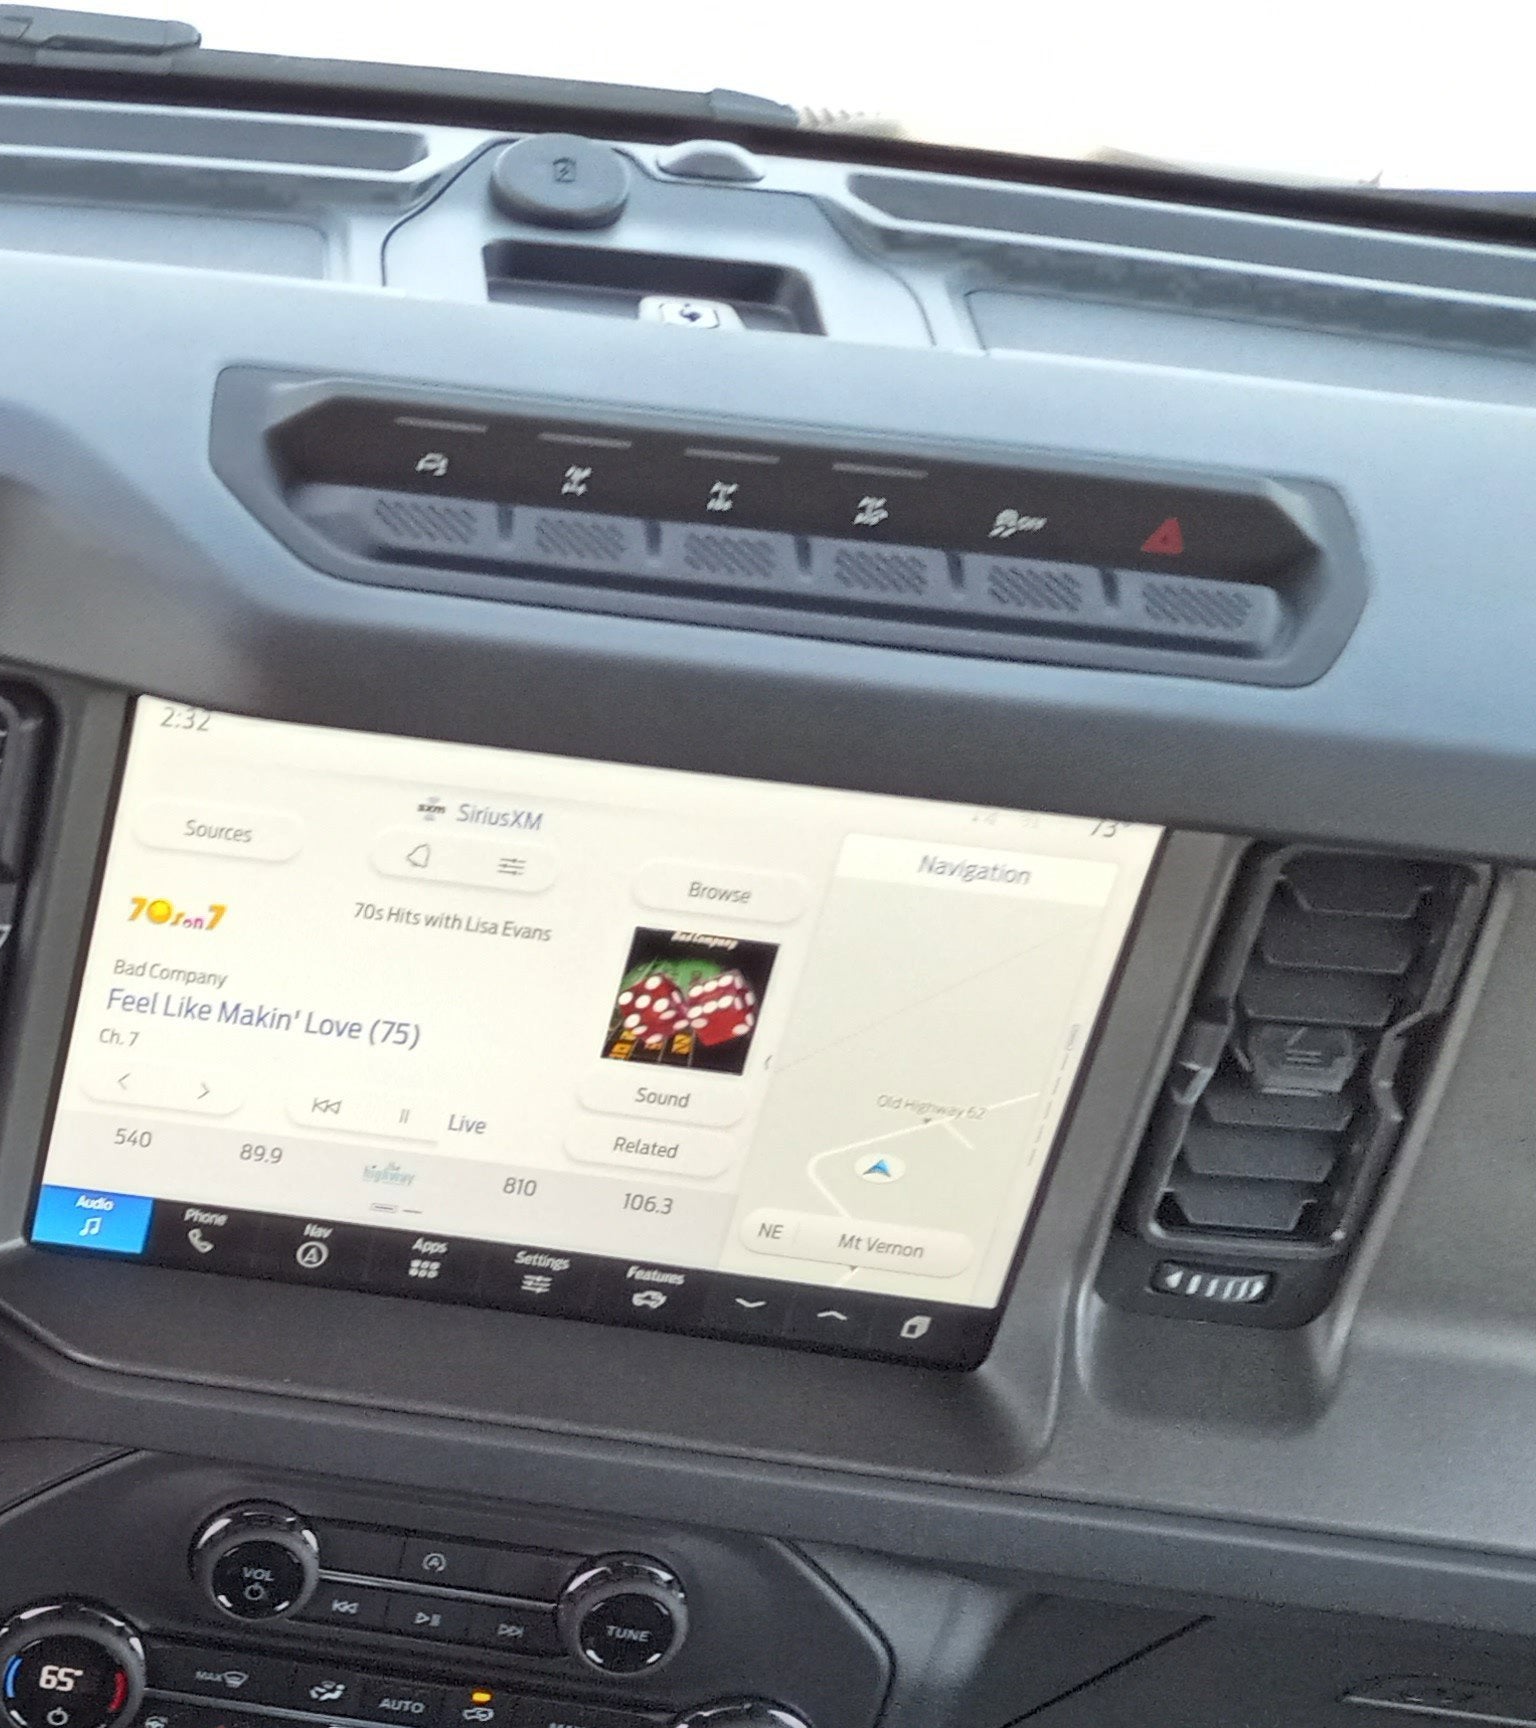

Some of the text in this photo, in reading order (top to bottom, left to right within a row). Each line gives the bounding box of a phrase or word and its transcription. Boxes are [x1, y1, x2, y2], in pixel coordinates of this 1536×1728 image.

[456, 803, 543, 831] SiriusXM
[183, 819, 253, 843] Sources
[918, 854, 1031, 887] Navigation
[688, 881, 752, 904] Browse
[354, 902, 552, 943] 70s Hits with Lisa Evans
[114, 959, 228, 989] Bad Company
[107, 988, 421, 1050] Feel Like Makin' Love (75)
[99, 1028, 140, 1047] Ch. 7
[635, 1086, 691, 1109] Sound
[447, 1113, 487, 1136] Live
[114, 1127, 153, 1149] 540
[613, 1136, 679, 1160] Related
[239, 1142, 284, 1166] 89.9
[502, 1176, 537, 1198] 810
[74, 1194, 114, 1213] Audio
[622, 1192, 674, 1216] 106.3
[183, 1207, 228, 1228] Phone
[304, 1223, 332, 1240] Nav
[757, 1221, 783, 1241] NE
[412, 1237, 448, 1257] Apps
[838, 1232, 925, 1259] Mt Vernon
[514, 1250, 570, 1274] Settings
[627, 1265, 685, 1287] Features
[242, 1566, 275, 1583] VOL
[606, 1625, 651, 1643] TUNE
[195, 1670, 222, 1682] MAX
[379, 1698, 425, 1715] AUTO
